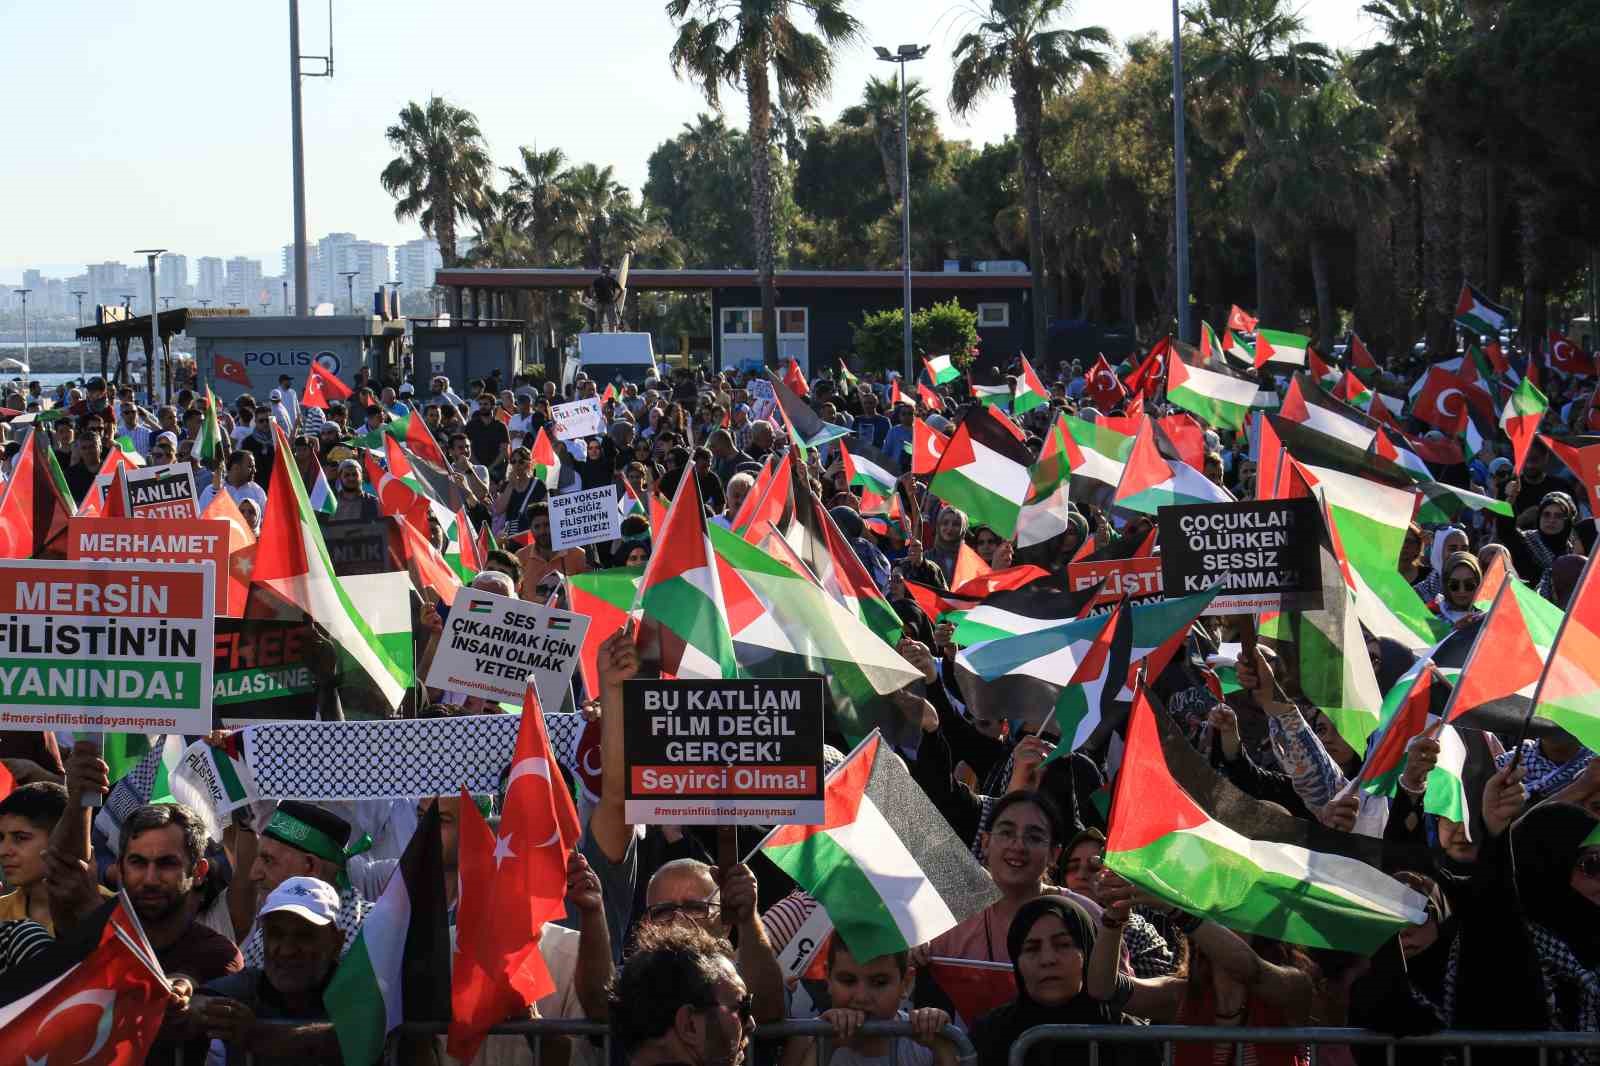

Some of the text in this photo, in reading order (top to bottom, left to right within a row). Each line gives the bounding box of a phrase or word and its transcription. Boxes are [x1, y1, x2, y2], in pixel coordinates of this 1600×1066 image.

[552, 489, 612, 508] SEN YOKSAN
[80, 533, 218, 554] MERHAMET
[1189, 529, 1288, 551] ÖLÜRKEN
[1203, 548, 1279, 571] SESSİZ
[16, 576, 169, 614] MERSİN
[503, 611, 537, 630] SES
[452, 618, 576, 658] ÇIKARMAK İÇİN
[451, 636, 564, 673] İNSAN OLMAK
[0, 667, 184, 700] YANINDA!
[213, 667, 309, 698] ALASTINE
[644, 685, 801, 710] BU KATLİAM
[2, 713, 176, 729] #mersinfilistindayanışması
[651, 709, 796, 736] FİLM DEĞİL
[665, 741, 782, 768] GERÇEK!
[641, 768, 808, 794] Seyirci Olma!
